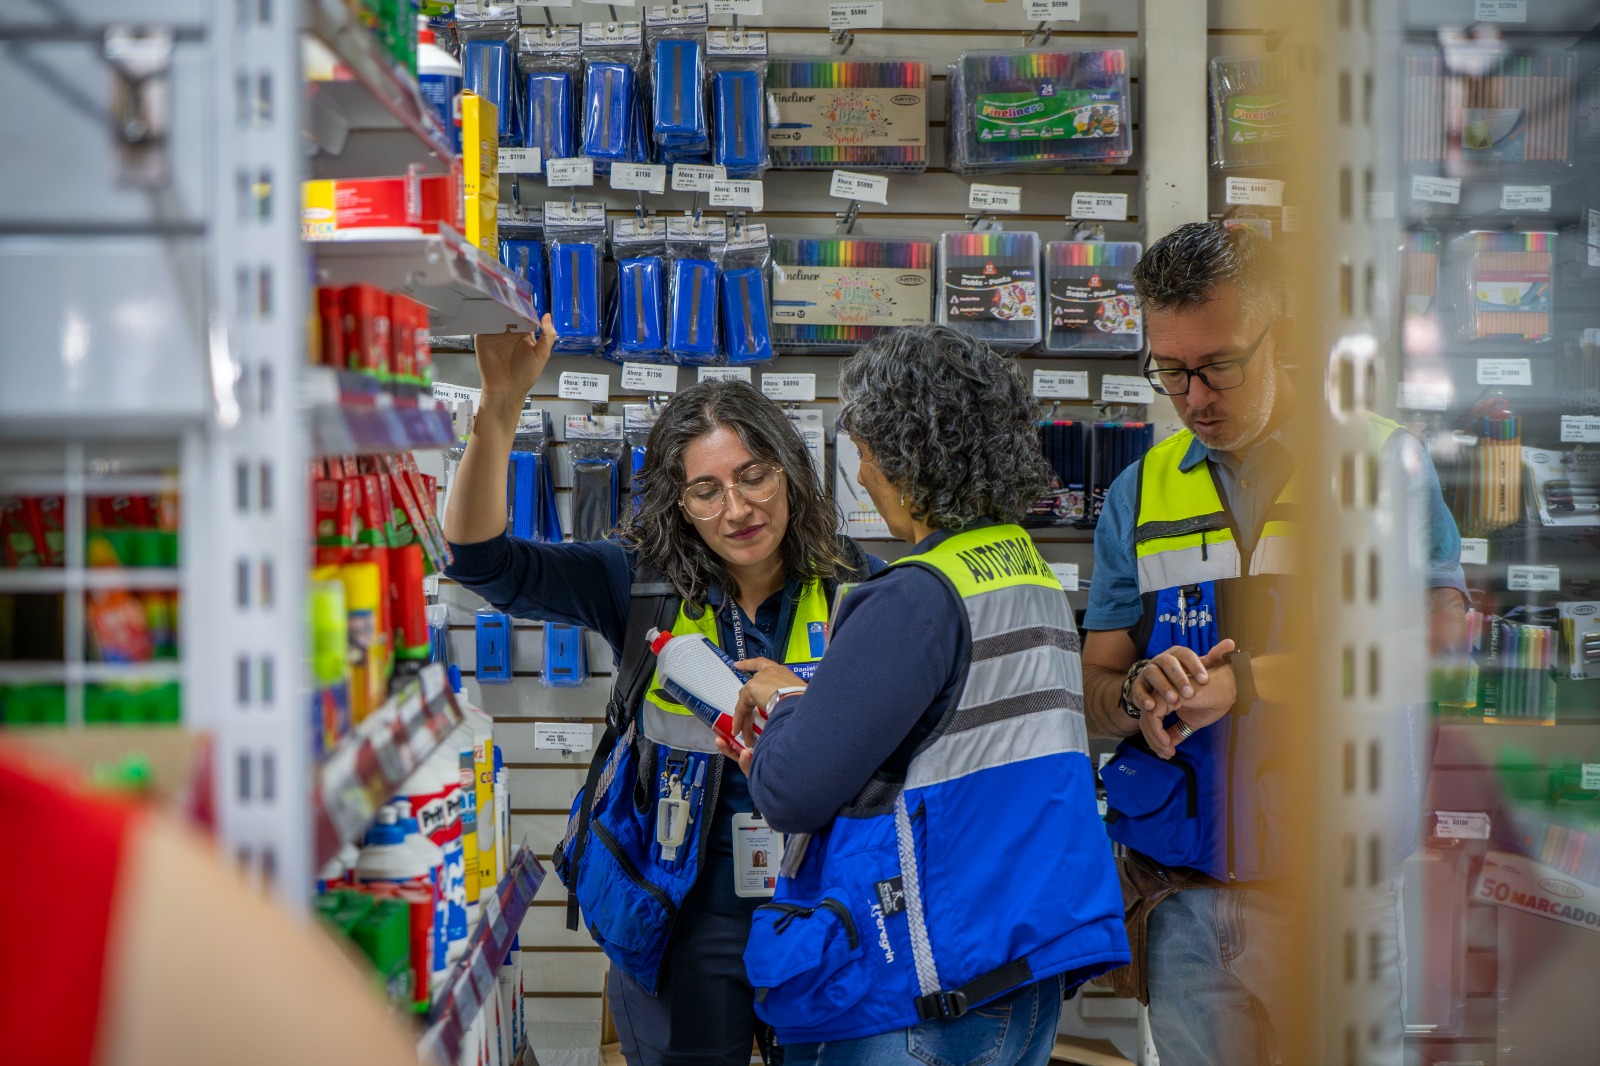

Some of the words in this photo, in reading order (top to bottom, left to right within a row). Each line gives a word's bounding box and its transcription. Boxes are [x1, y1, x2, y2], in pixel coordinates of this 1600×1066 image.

[1041, 84, 1053, 94] 24
[982, 103, 1045, 118] Fineliners
[989, 276, 1012, 286] Punta
[1094, 290, 1116, 298] Punta
[434, 390, 450, 398] Ahora:
[454, 392, 470, 400] $1950
[732, 610, 740, 620] DE
[734, 621, 743, 648] SALUD
[1480, 878, 1510, 902] 50
[1543, 880, 1580, 896] ARTEL
